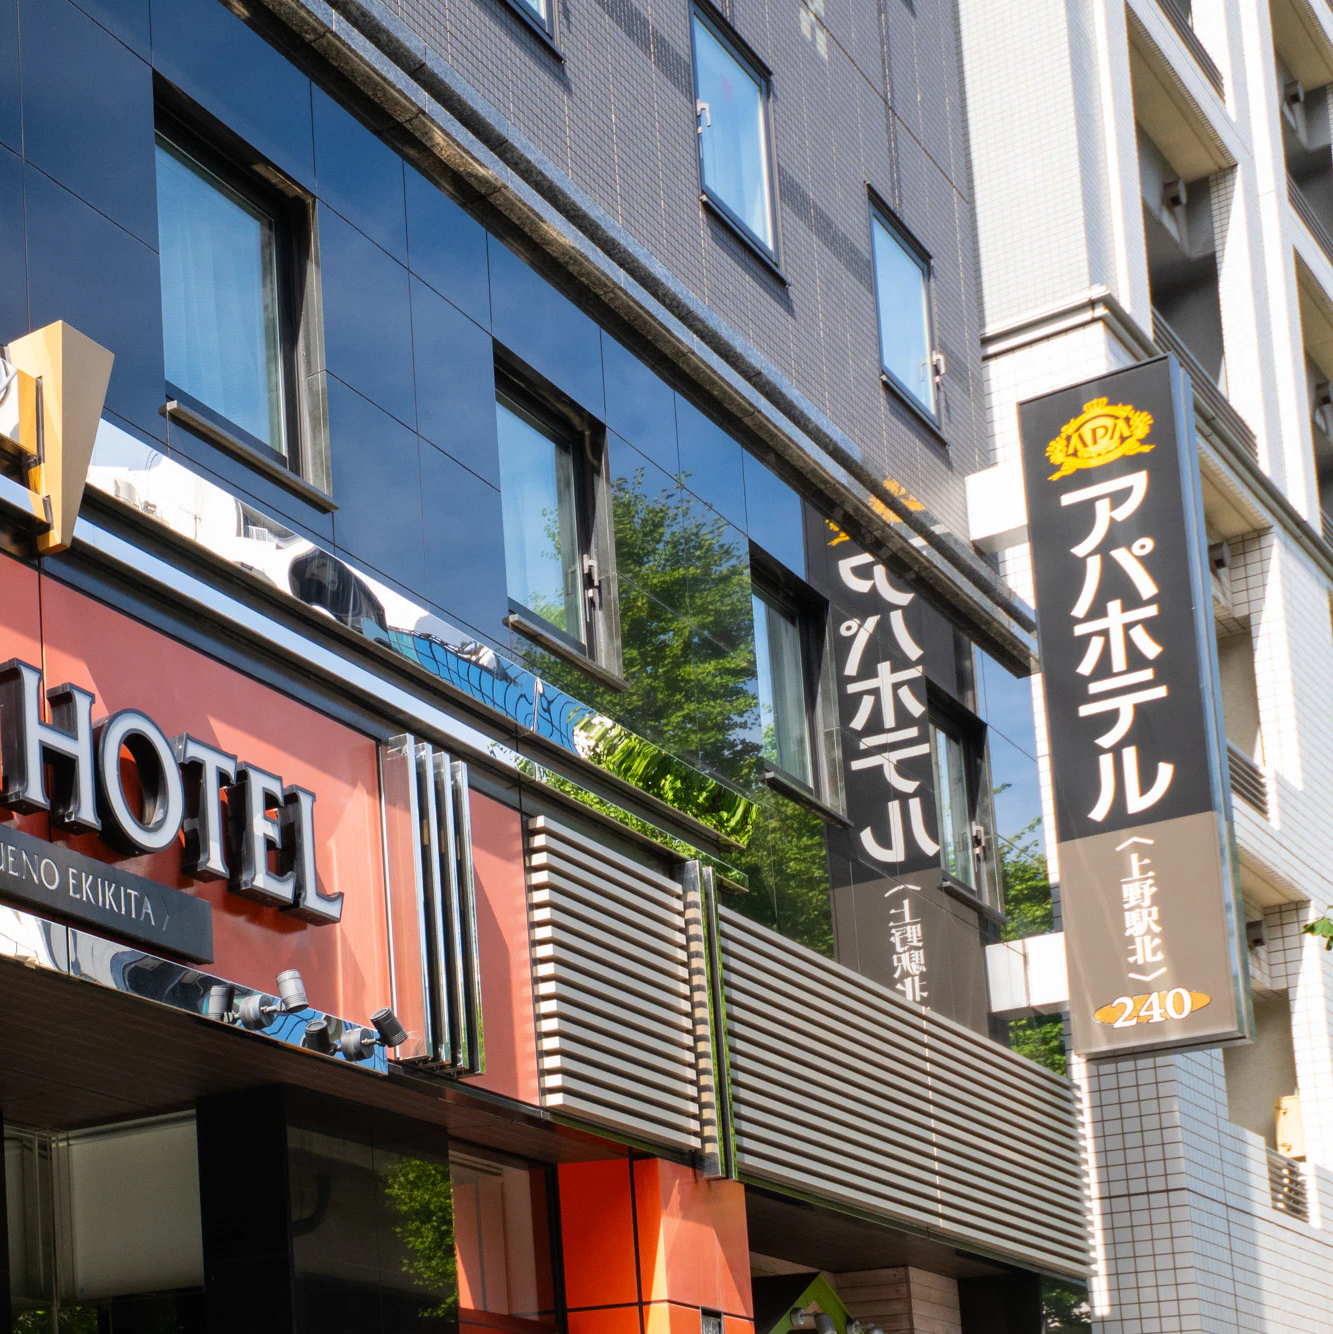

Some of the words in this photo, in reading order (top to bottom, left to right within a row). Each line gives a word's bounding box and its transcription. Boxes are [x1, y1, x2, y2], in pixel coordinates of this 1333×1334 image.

[1060, 470, 1175, 823] アパホテル
[1111, 987, 1192, 1029] 240
